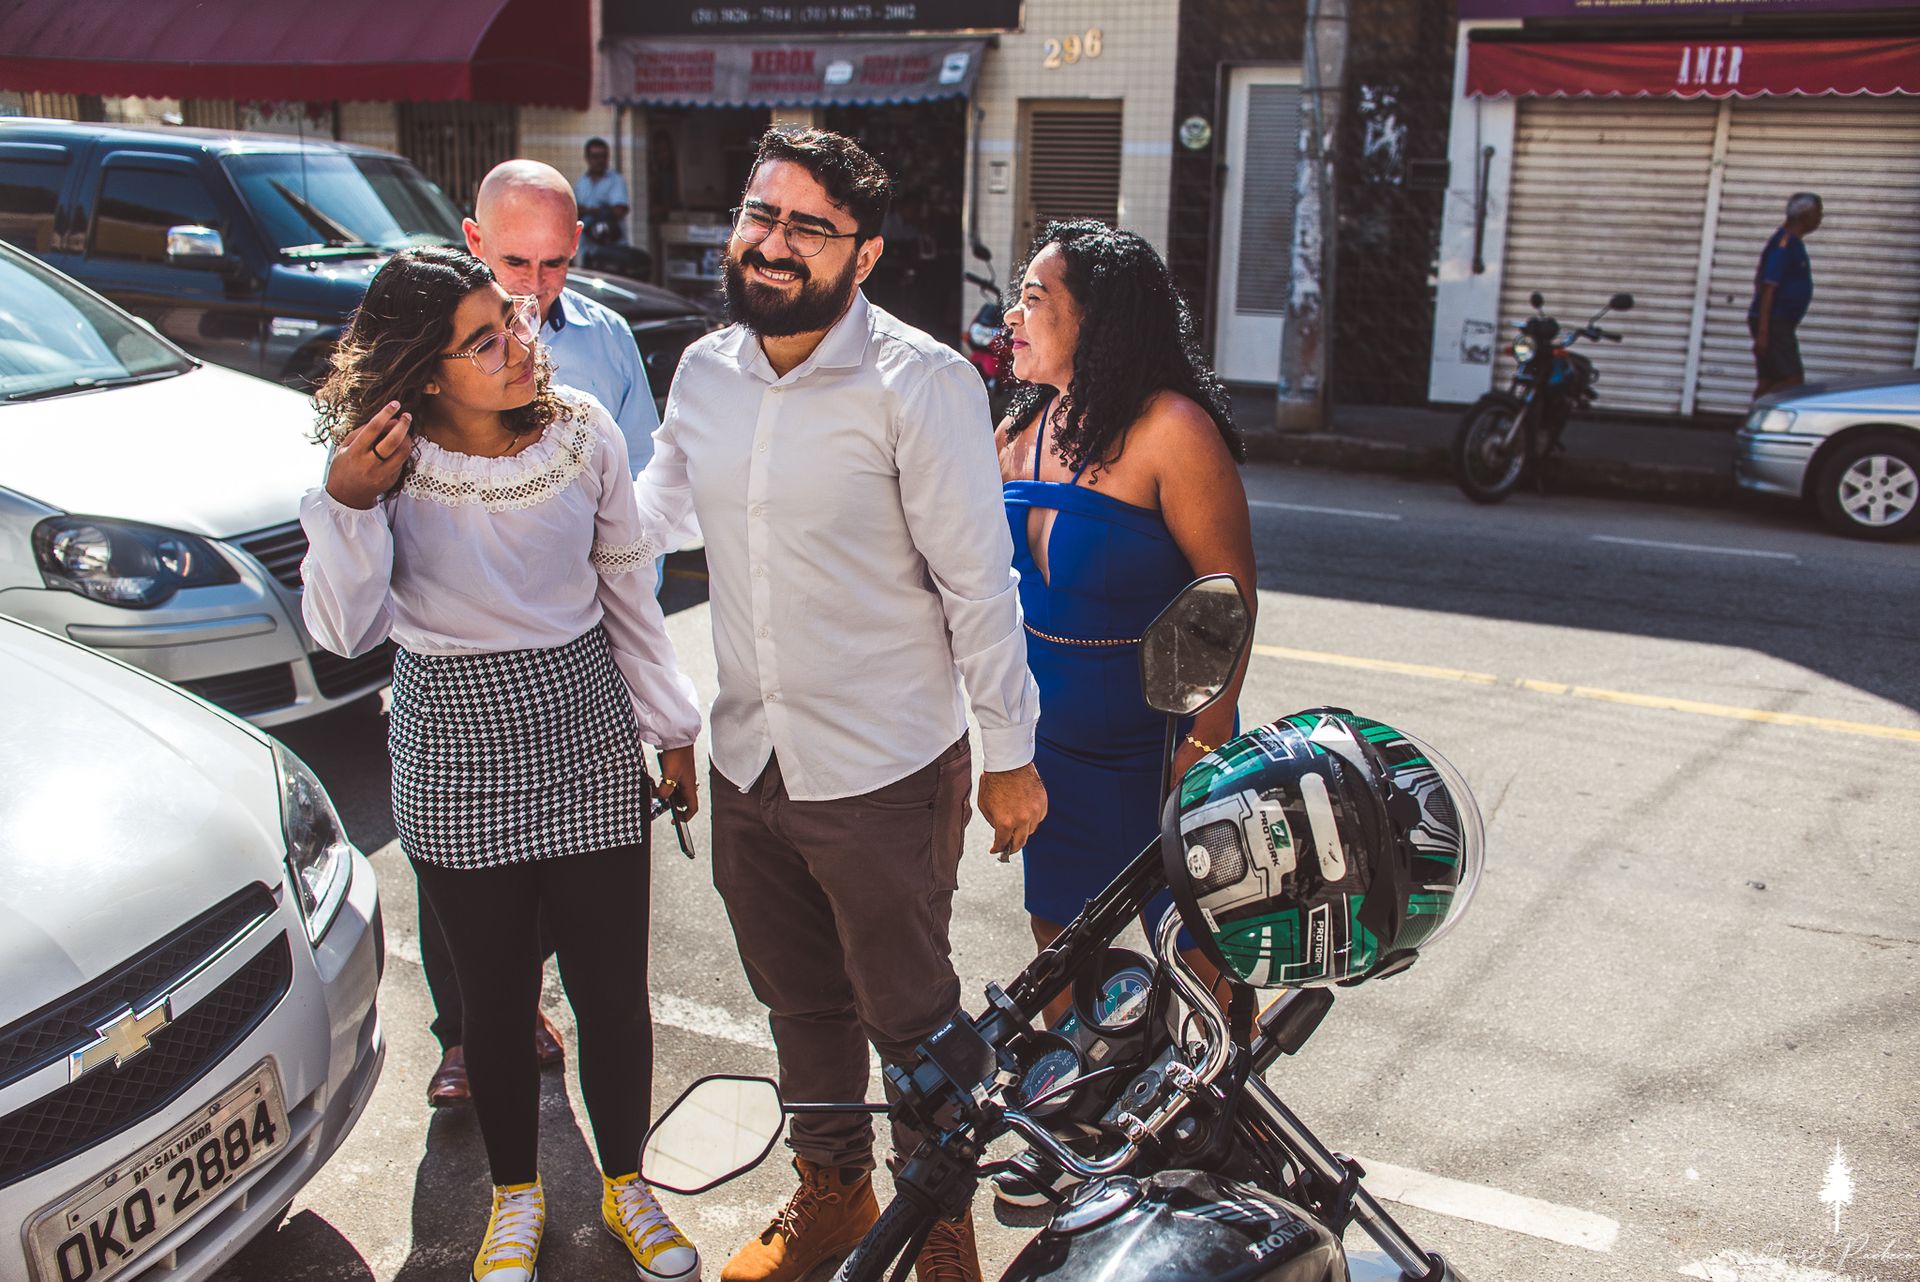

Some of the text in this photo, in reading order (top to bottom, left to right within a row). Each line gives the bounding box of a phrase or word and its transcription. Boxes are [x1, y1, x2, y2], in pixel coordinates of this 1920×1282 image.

[752, 49, 817, 75] XEROX
[1043, 28, 1103, 69] 296
[1246, 1220, 1314, 1260] HONDA
